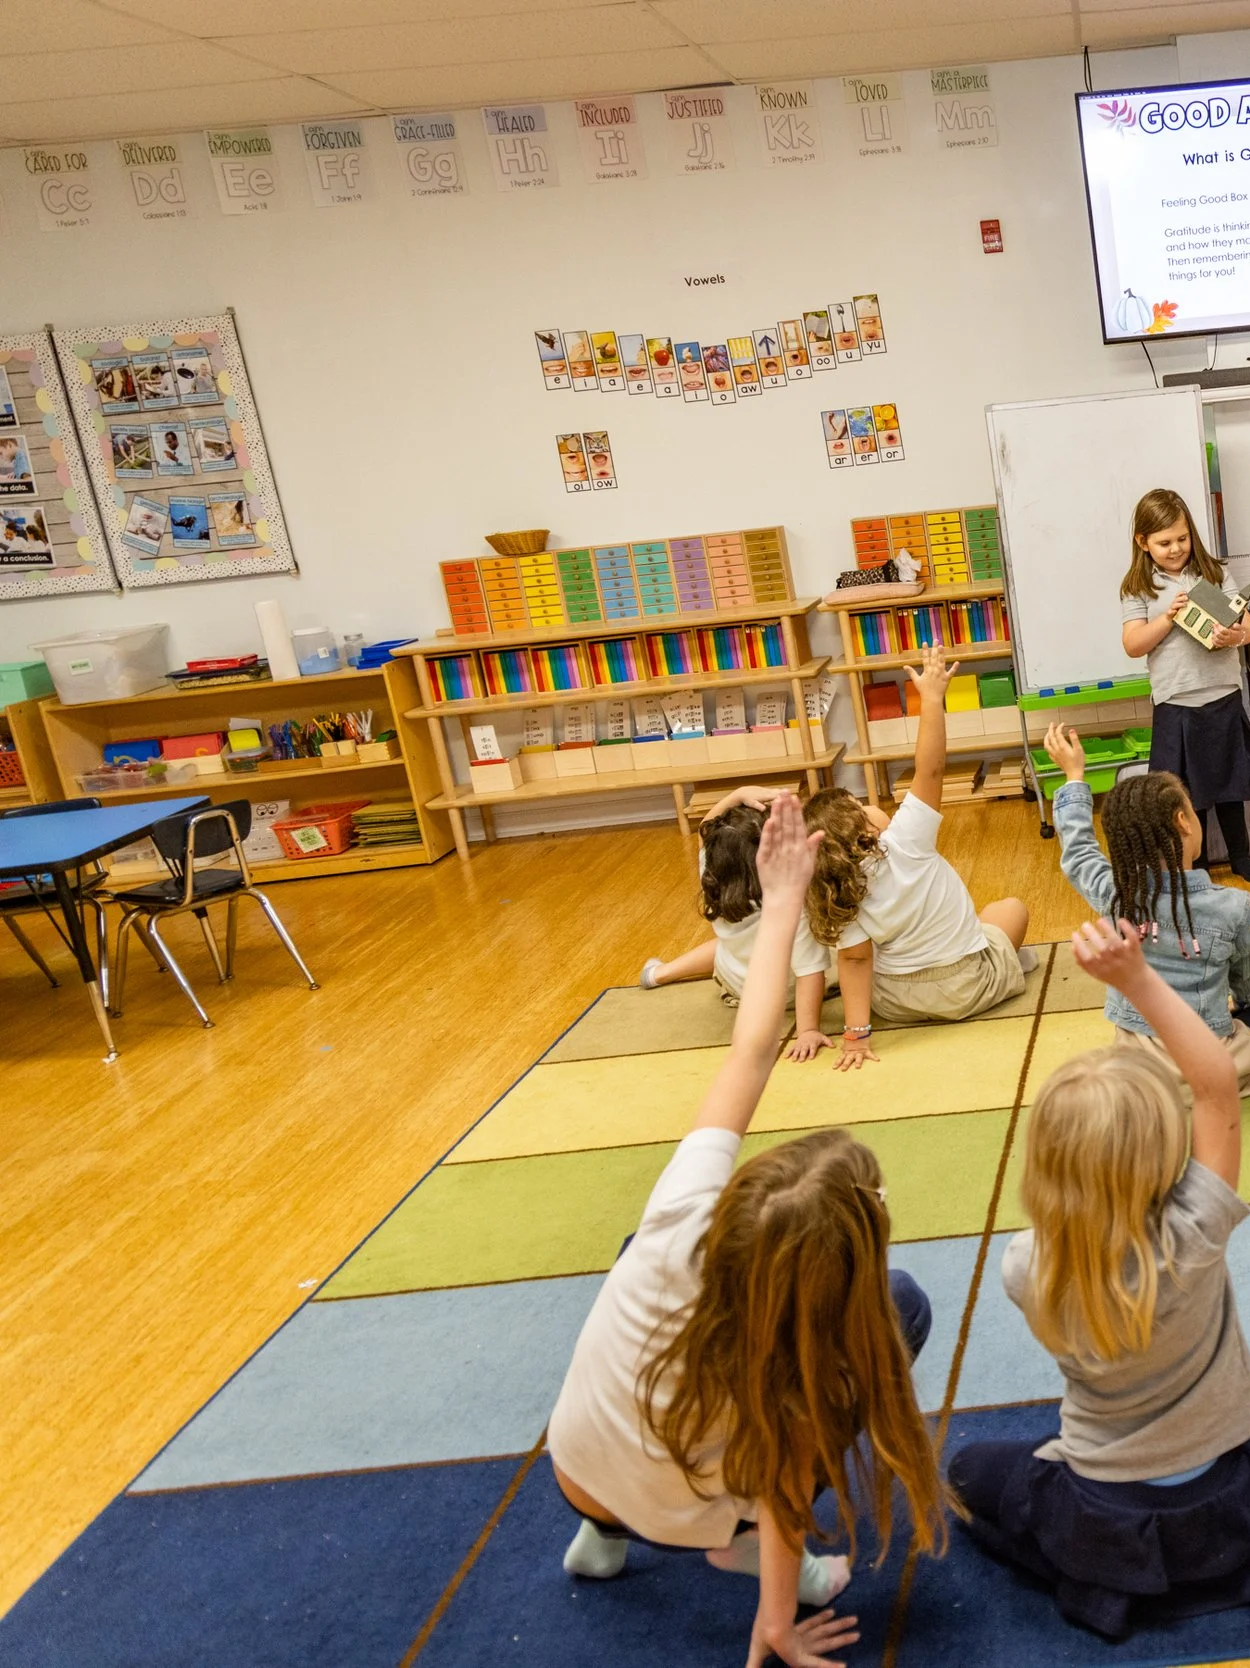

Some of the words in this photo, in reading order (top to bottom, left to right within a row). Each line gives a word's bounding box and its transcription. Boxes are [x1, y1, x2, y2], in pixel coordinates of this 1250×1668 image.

[931, 76, 989, 92] MASTERPIECE
[759, 91, 808, 111] KNOWN
[855, 83, 889, 103] LOVED
[580, 106, 632, 127] INCLUDED
[667, 99, 724, 120] JUSTIFIED
[935, 100, 996, 133] Mm
[1138, 97, 1231, 134] GOOD
[497, 113, 536, 133] HEALED
[861, 105, 892, 143] Ll
[394, 122, 456, 141] GRACE-FILLED
[764, 113, 816, 151] Kk
[209, 136, 271, 156] EMPOWERED
[304, 131, 362, 149] FORGIVEN
[594, 129, 630, 166] Ii
[687, 122, 715, 165] Jj
[25, 155, 61, 175] CARED
[66, 152, 89, 170] FOR
[122, 145, 177, 166] DELIVERED
[495, 138, 549, 175] Hh
[1182, 151, 1219, 166] What
[1224, 150, 1235, 163] is
[316, 153, 360, 190] Ff
[407, 146, 459, 188] Gg
[130, 167, 187, 207] Dd
[221, 162, 276, 199] Ee
[40, 178, 93, 216] Cc
[1161, 196, 1197, 209] Feeling
[1199, 193, 1228, 205] Good
[1230, 191, 1249, 202] Box
[1164, 224, 1211, 238] Gratitude
[1213, 223, 1221, 233] is
[1165, 241, 1187, 253] and
[1188, 239, 1209, 250] how
[1211, 237, 1233, 251] they
[1168, 255, 1190, 267] Then
[684, 273, 726, 288] Vowels
[1169, 269, 1198, 282] things
[1199, 267, 1213, 278] for
[1214, 266, 1236, 279] you!
[845, 350, 853, 359] u
[866, 342, 881, 353] yu
[816, 357, 831, 367] oo
[553, 376, 561, 385] e
[771, 375, 778, 385] u
[796, 369, 803, 377] o
[608, 379, 617, 387] a
[636, 383, 645, 392] e
[664, 386, 672, 394] a
[740, 385, 758, 395] aw
[720, 393, 727, 402] o
[834, 456, 848, 466] ar
[860, 453, 873, 462] er
[885, 450, 900, 460] or
[9, 484, 28, 492] data.
[573, 481, 585, 491] oi
[596, 479, 614, 489] ow
[9, 554, 50, 563] conclusion.
